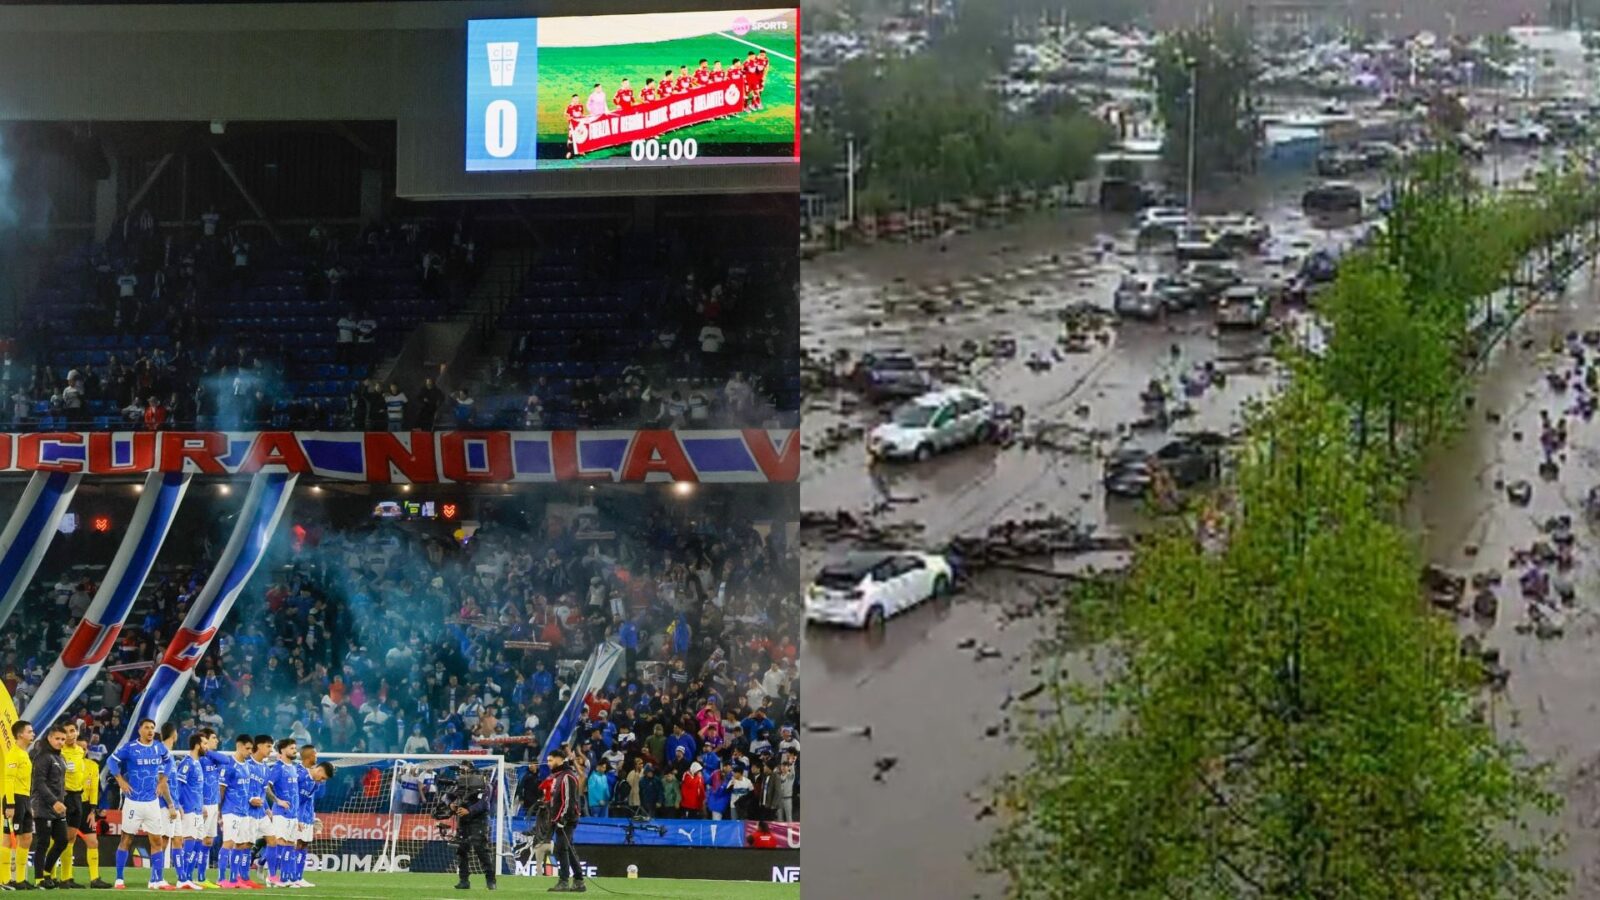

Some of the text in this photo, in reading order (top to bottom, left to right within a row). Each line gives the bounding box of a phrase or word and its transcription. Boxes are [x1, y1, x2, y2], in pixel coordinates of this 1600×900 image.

[751, 21, 788, 31] SPORTS
[485, 99, 518, 158] 0
[630, 138, 698, 161] 00:00
[0, 431, 312, 474] CURA
[364, 430, 515, 484] NO
[553, 429, 700, 483] LA
[128, 809, 135, 820] 9
[330, 823, 383, 840] Claro
